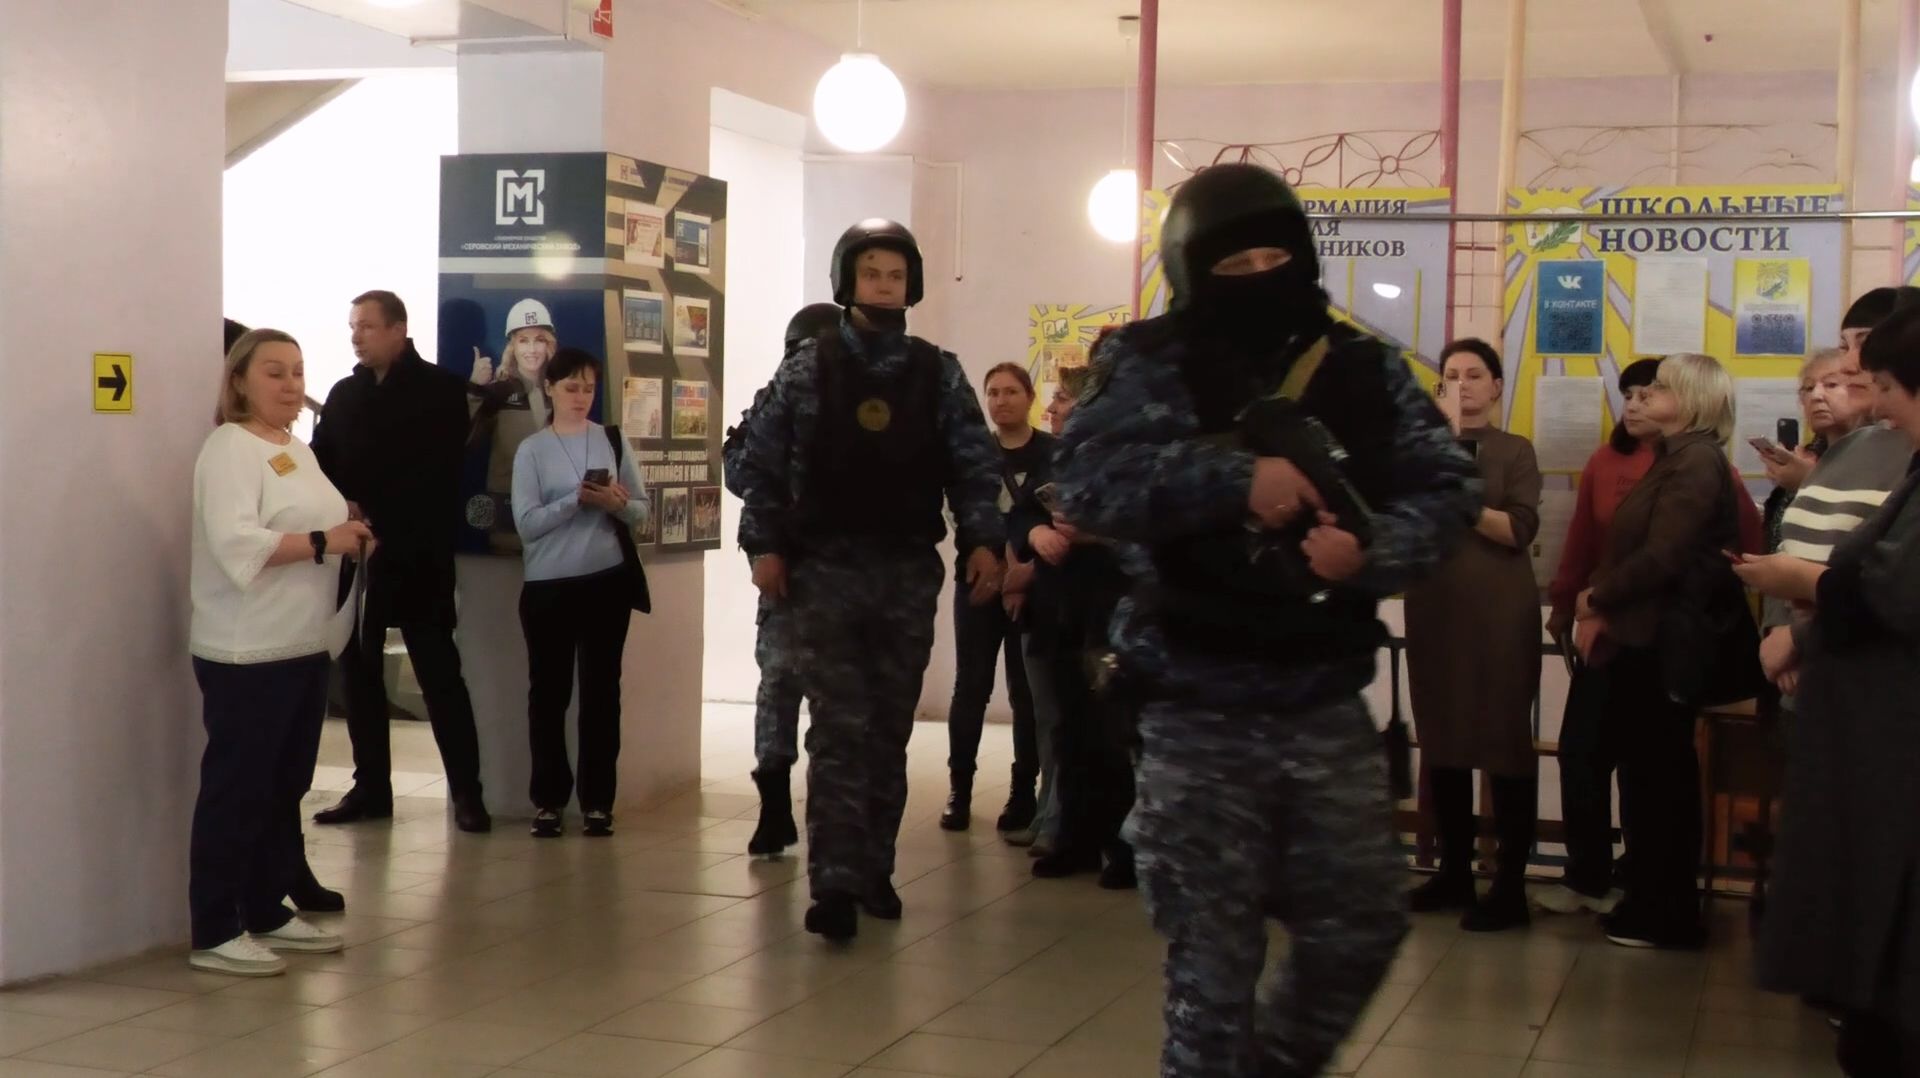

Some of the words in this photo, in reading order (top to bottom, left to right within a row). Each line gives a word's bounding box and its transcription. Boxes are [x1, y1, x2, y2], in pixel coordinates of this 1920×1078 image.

[1304, 199, 1407, 214] РМАЦИЯ
[1599, 195, 1830, 216] ШКОЛЬНЫЕ
[1311, 220, 1341, 236] ЛЯ
[1598, 226, 1790, 253] НОВОСТИ
[1319, 240, 1405, 256] НИКОВ
